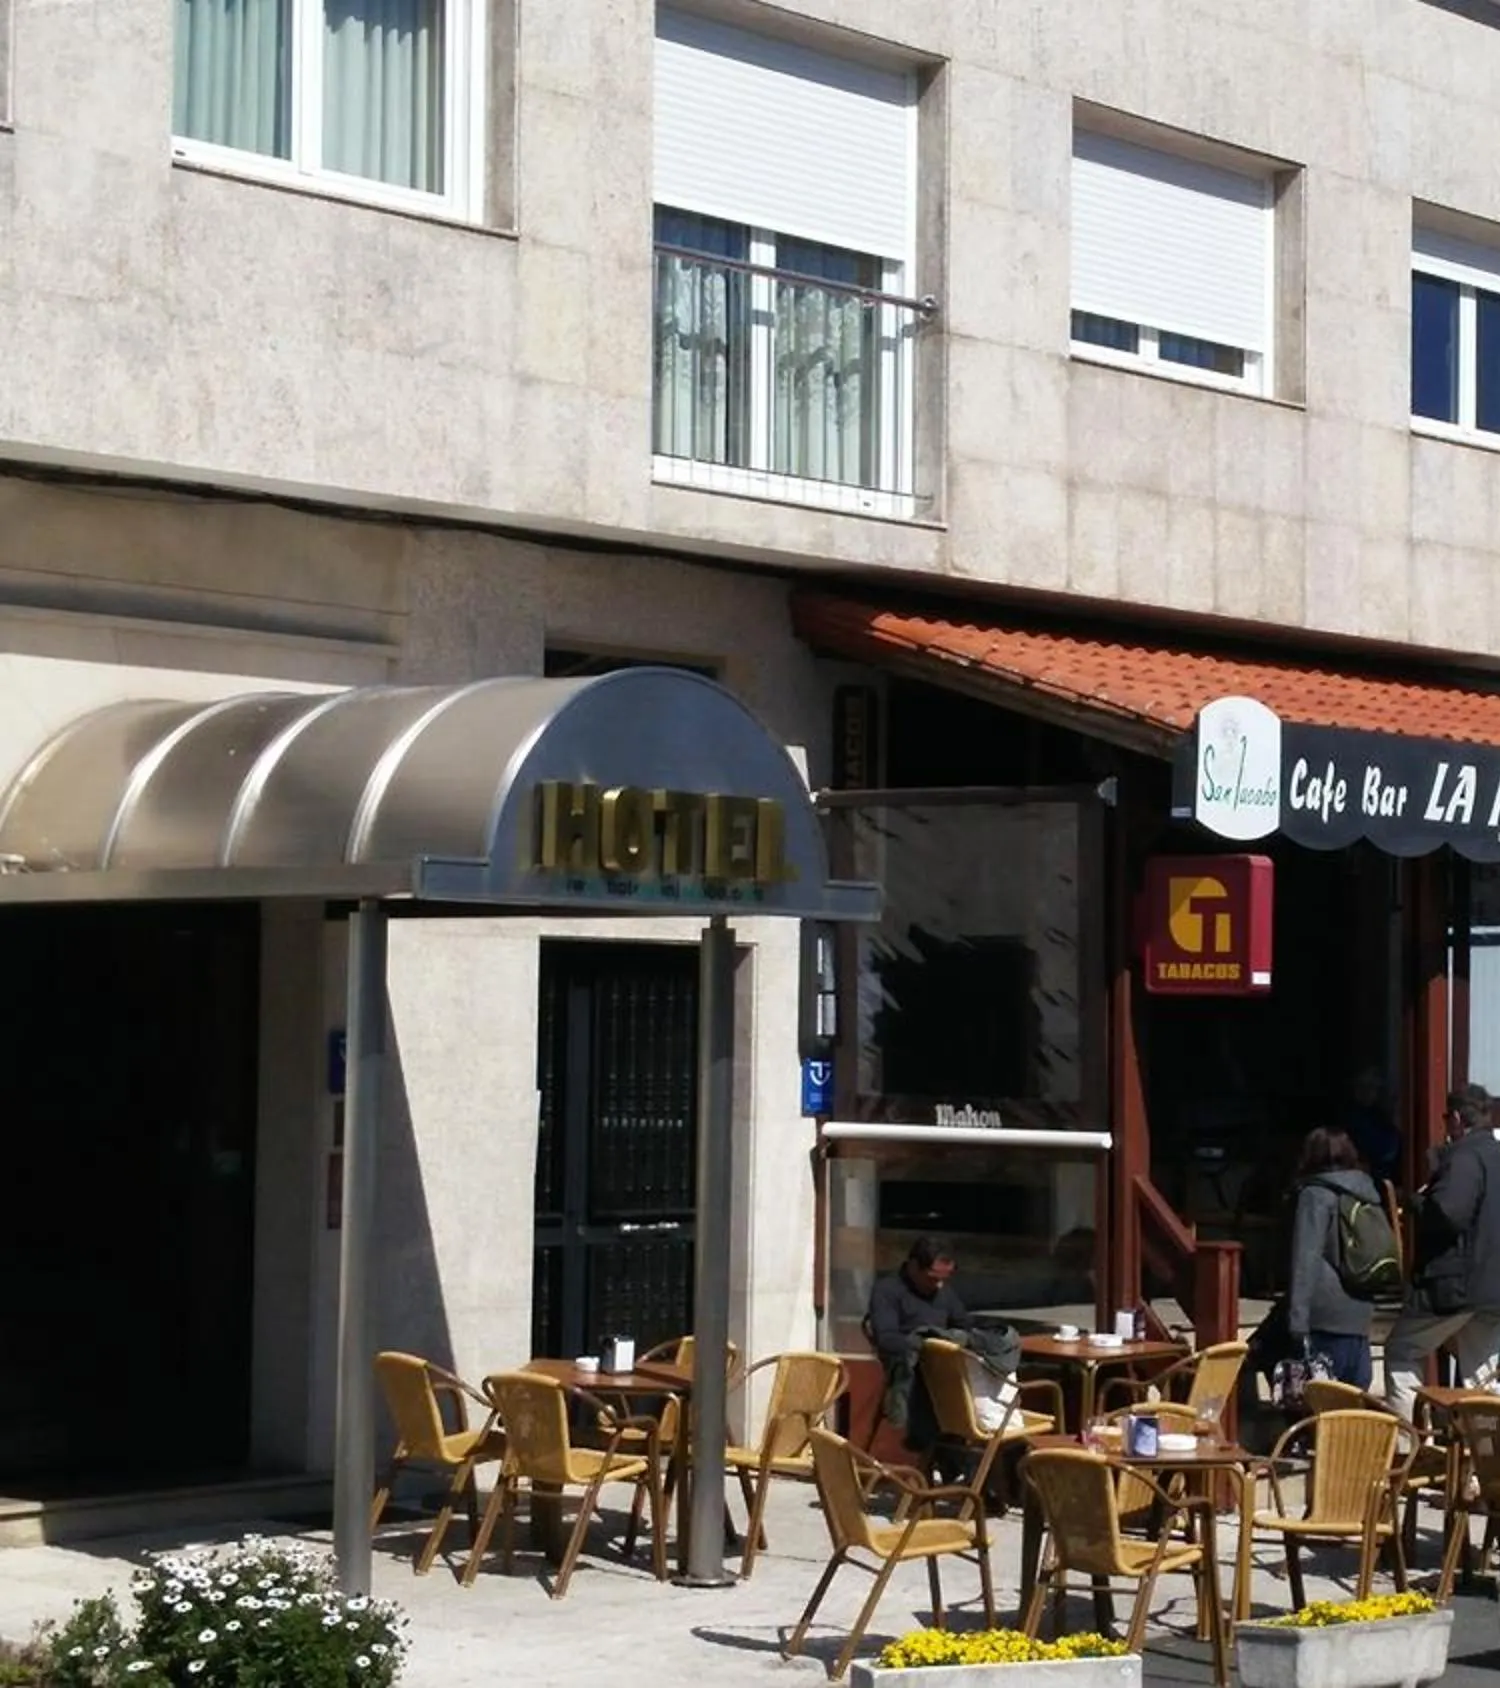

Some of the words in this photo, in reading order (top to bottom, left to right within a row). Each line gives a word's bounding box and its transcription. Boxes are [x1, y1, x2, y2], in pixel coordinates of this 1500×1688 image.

[1289, 757, 1347, 824] Cafe
[1362, 765, 1408, 817] Bar
[1423, 762, 1477, 824] LA
[528, 779, 795, 883] HOTEL
[1157, 962, 1241, 980] TABACOS
